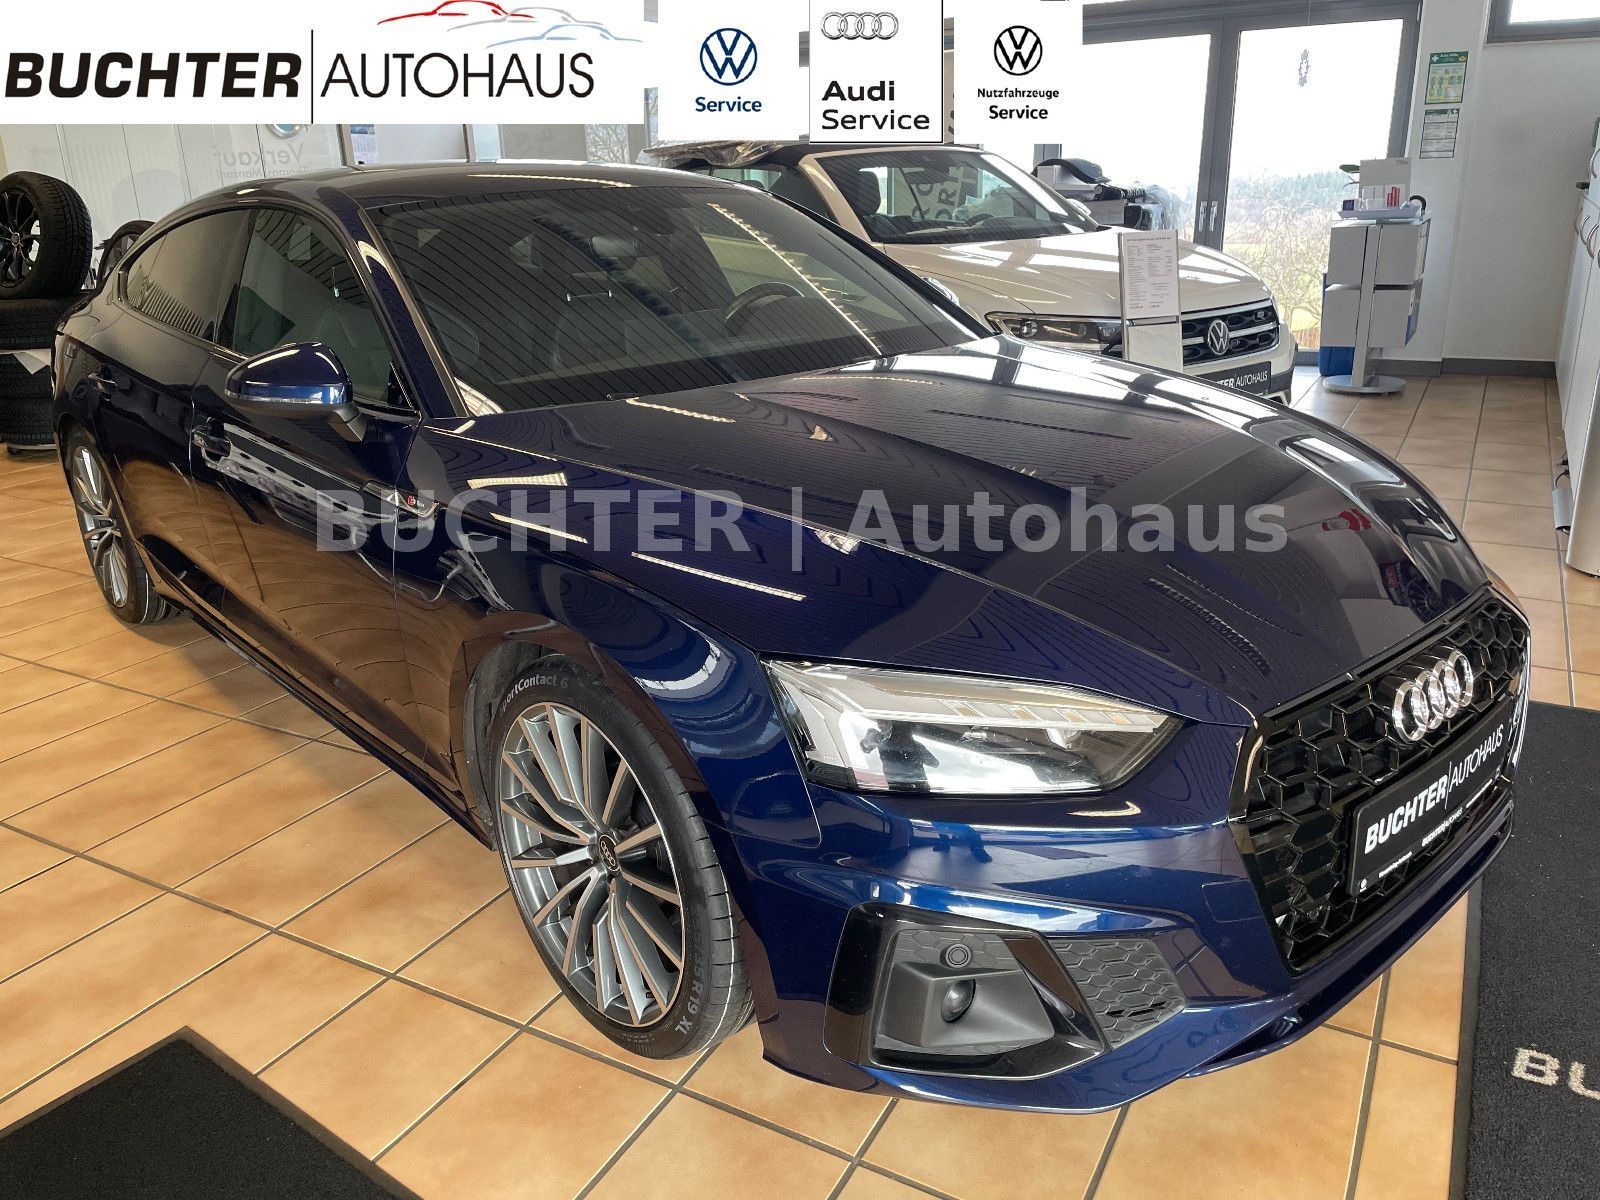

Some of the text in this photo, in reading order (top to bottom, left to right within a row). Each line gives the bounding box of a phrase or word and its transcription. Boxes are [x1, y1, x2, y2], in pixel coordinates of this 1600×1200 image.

[1236, 370, 1268, 387] AUTOHAUS
[502, 673, 558, 713] portContact
[1364, 774, 1449, 855] BUCHTER
[1448, 723, 1504, 793] AUTOHAUS
[674, 1015, 693, 1036] XL
